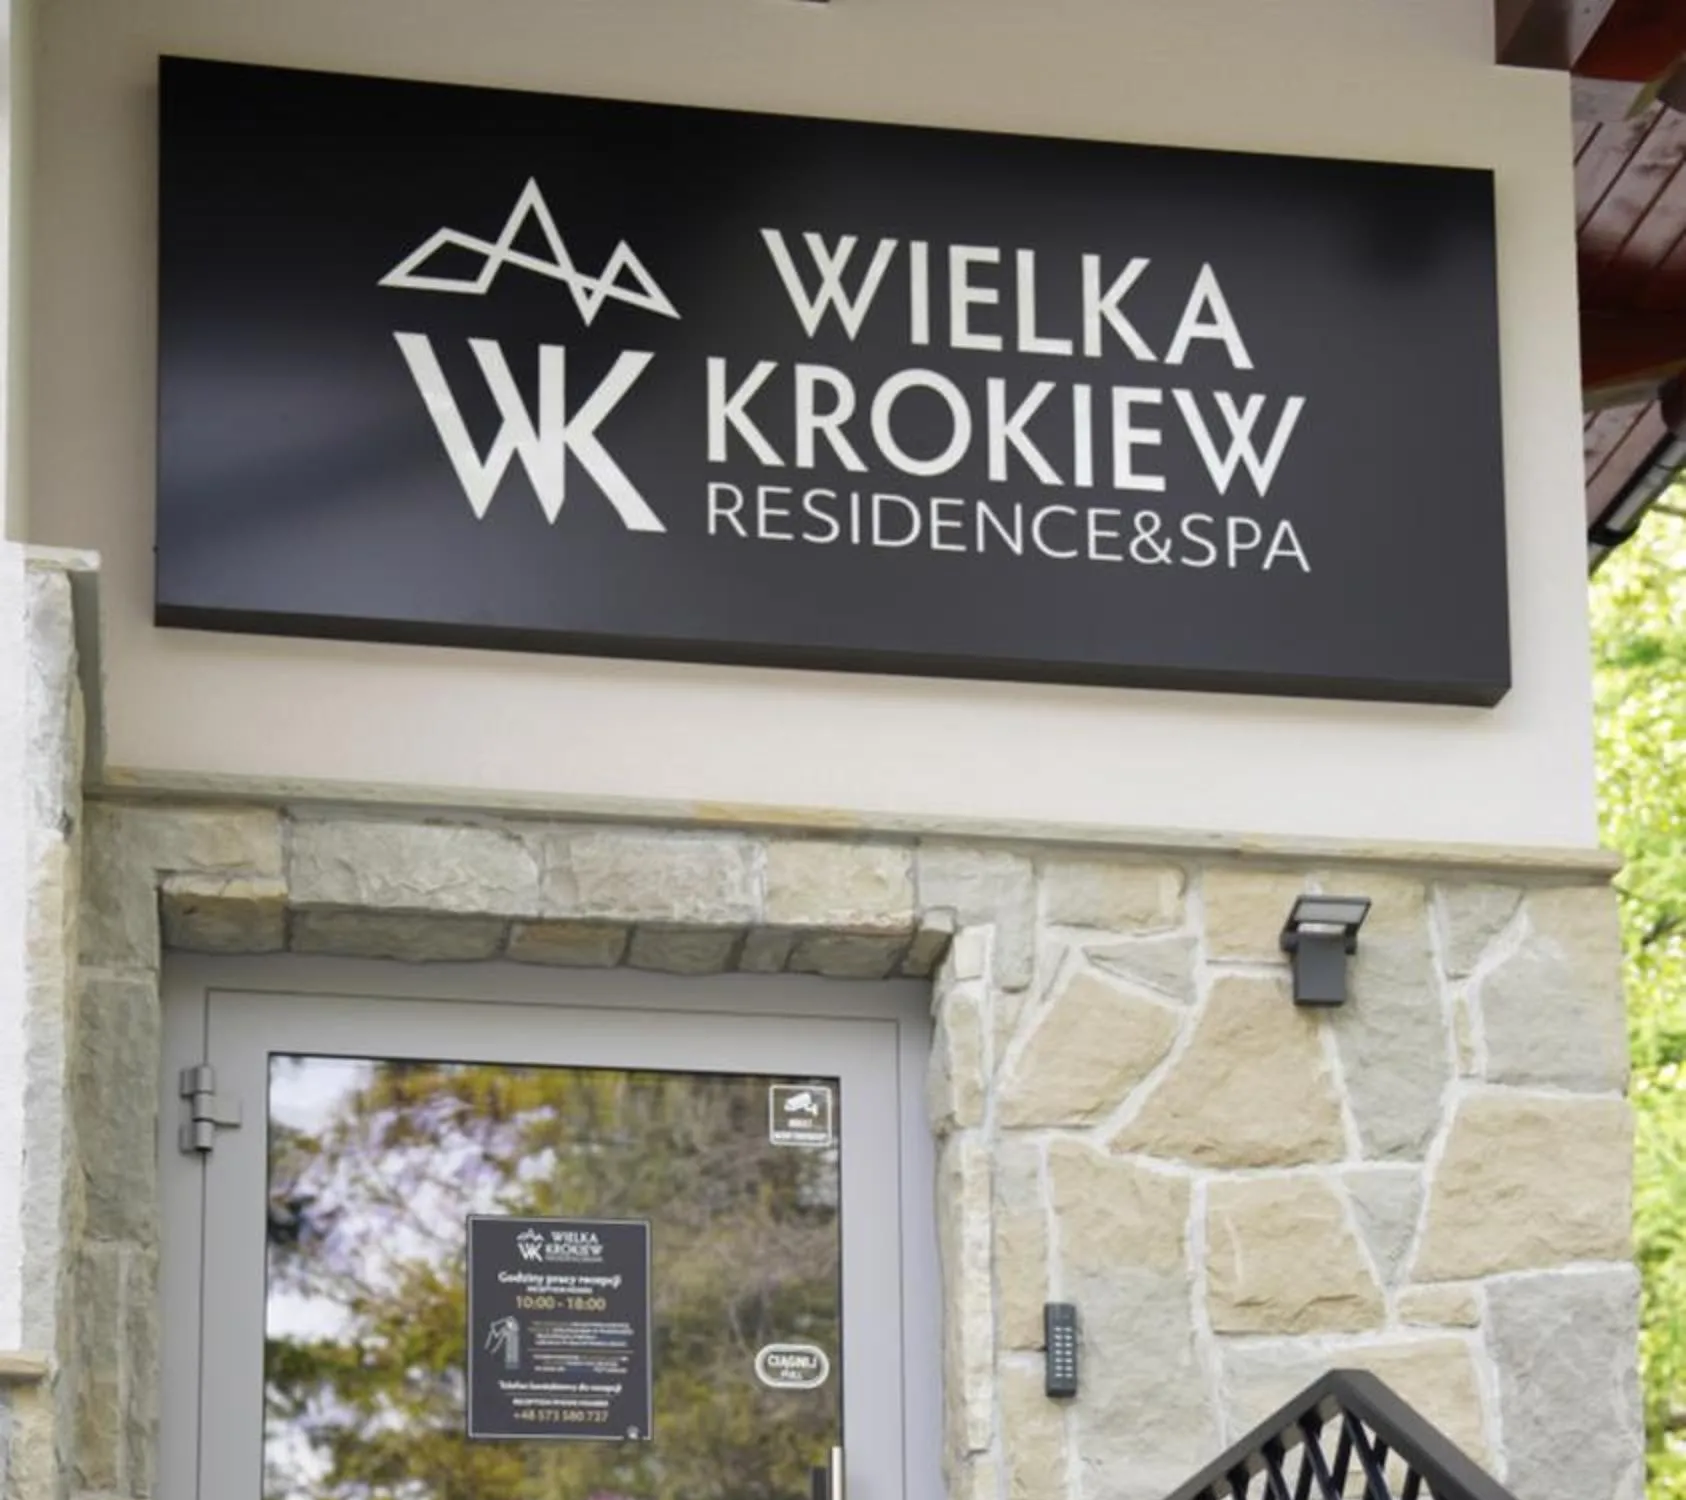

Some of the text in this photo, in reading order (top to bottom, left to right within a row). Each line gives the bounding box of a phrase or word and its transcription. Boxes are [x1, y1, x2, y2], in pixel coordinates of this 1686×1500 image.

[761, 229, 1254, 370] WIELKA
[393, 331, 667, 534] WK
[707, 357, 1306, 497] KROKIEW
[707, 482, 1312, 573] RESIDENCE&SPA
[516, 1295, 556, 1309] 10:00
